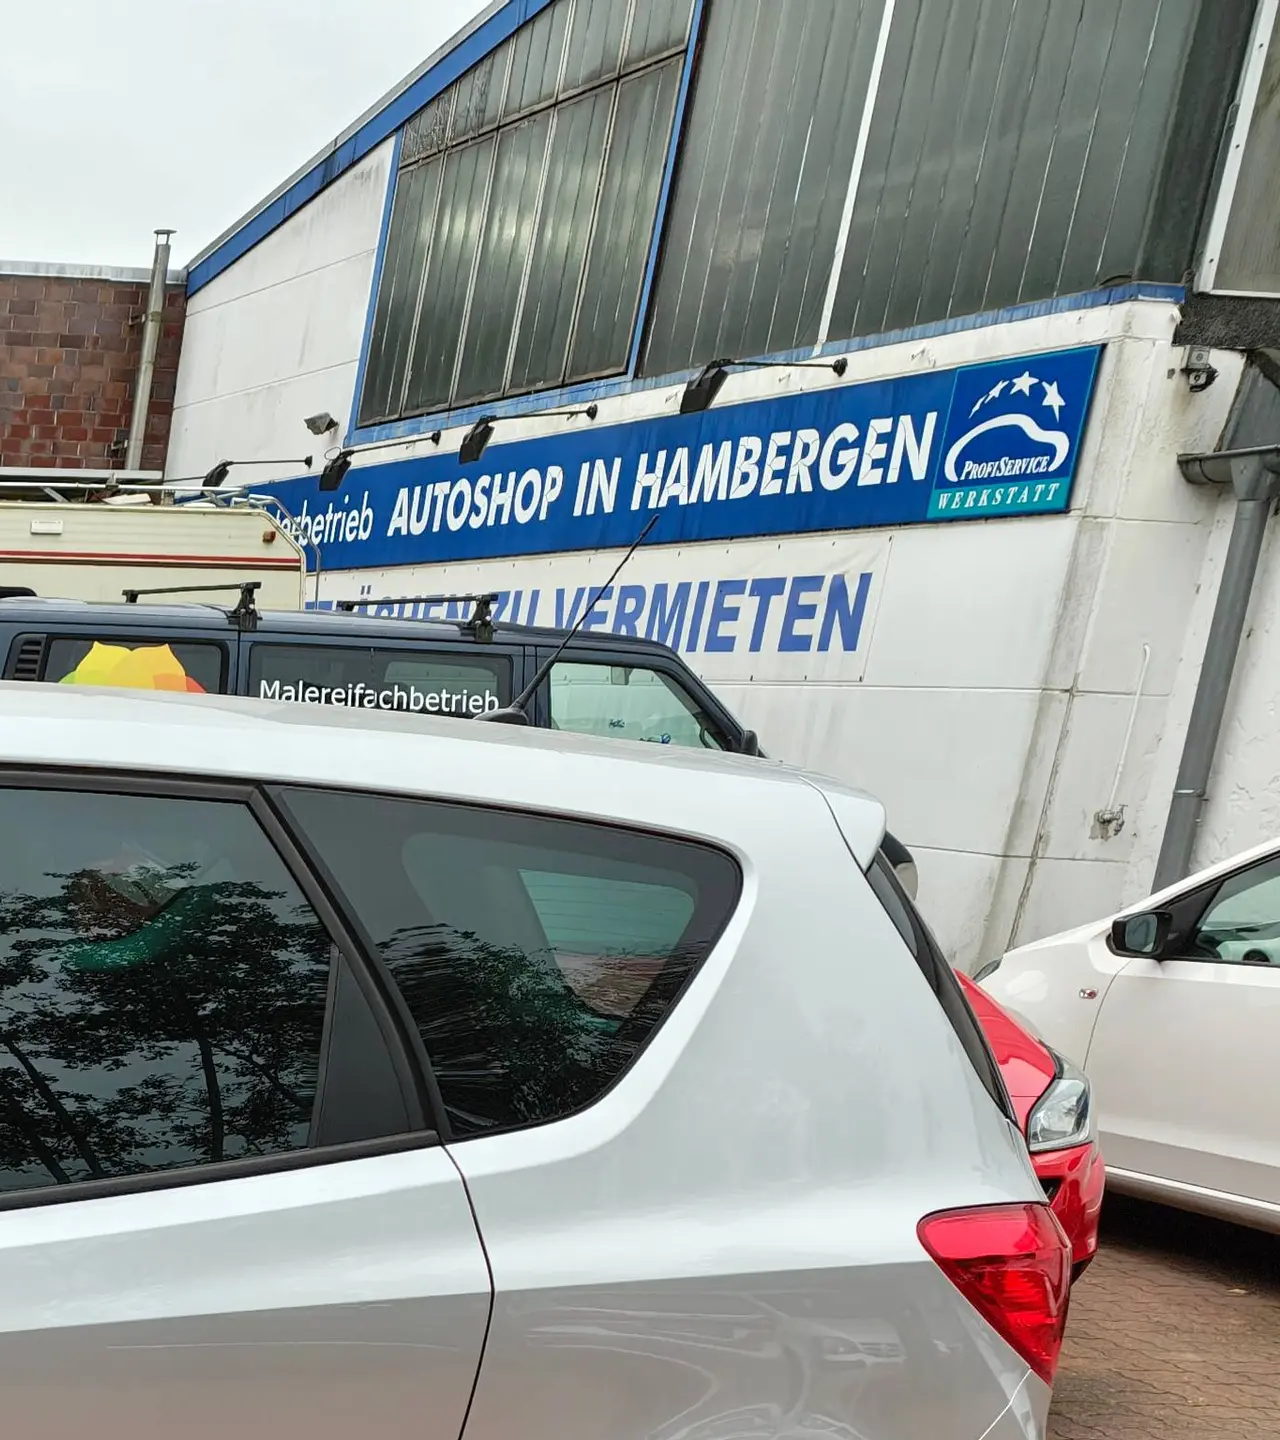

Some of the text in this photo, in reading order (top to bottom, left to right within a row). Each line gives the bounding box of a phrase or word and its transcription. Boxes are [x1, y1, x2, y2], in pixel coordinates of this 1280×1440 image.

[387, 465, 564, 538] AUTOSHOP
[572, 457, 622, 517] IN
[630, 411, 938, 511] HAMBERGEN
[938, 482, 1060, 510] WERKSTATT
[555, 573, 872, 653] VERMIETEN
[260, 679, 499, 713] Malereifachbetrieb
